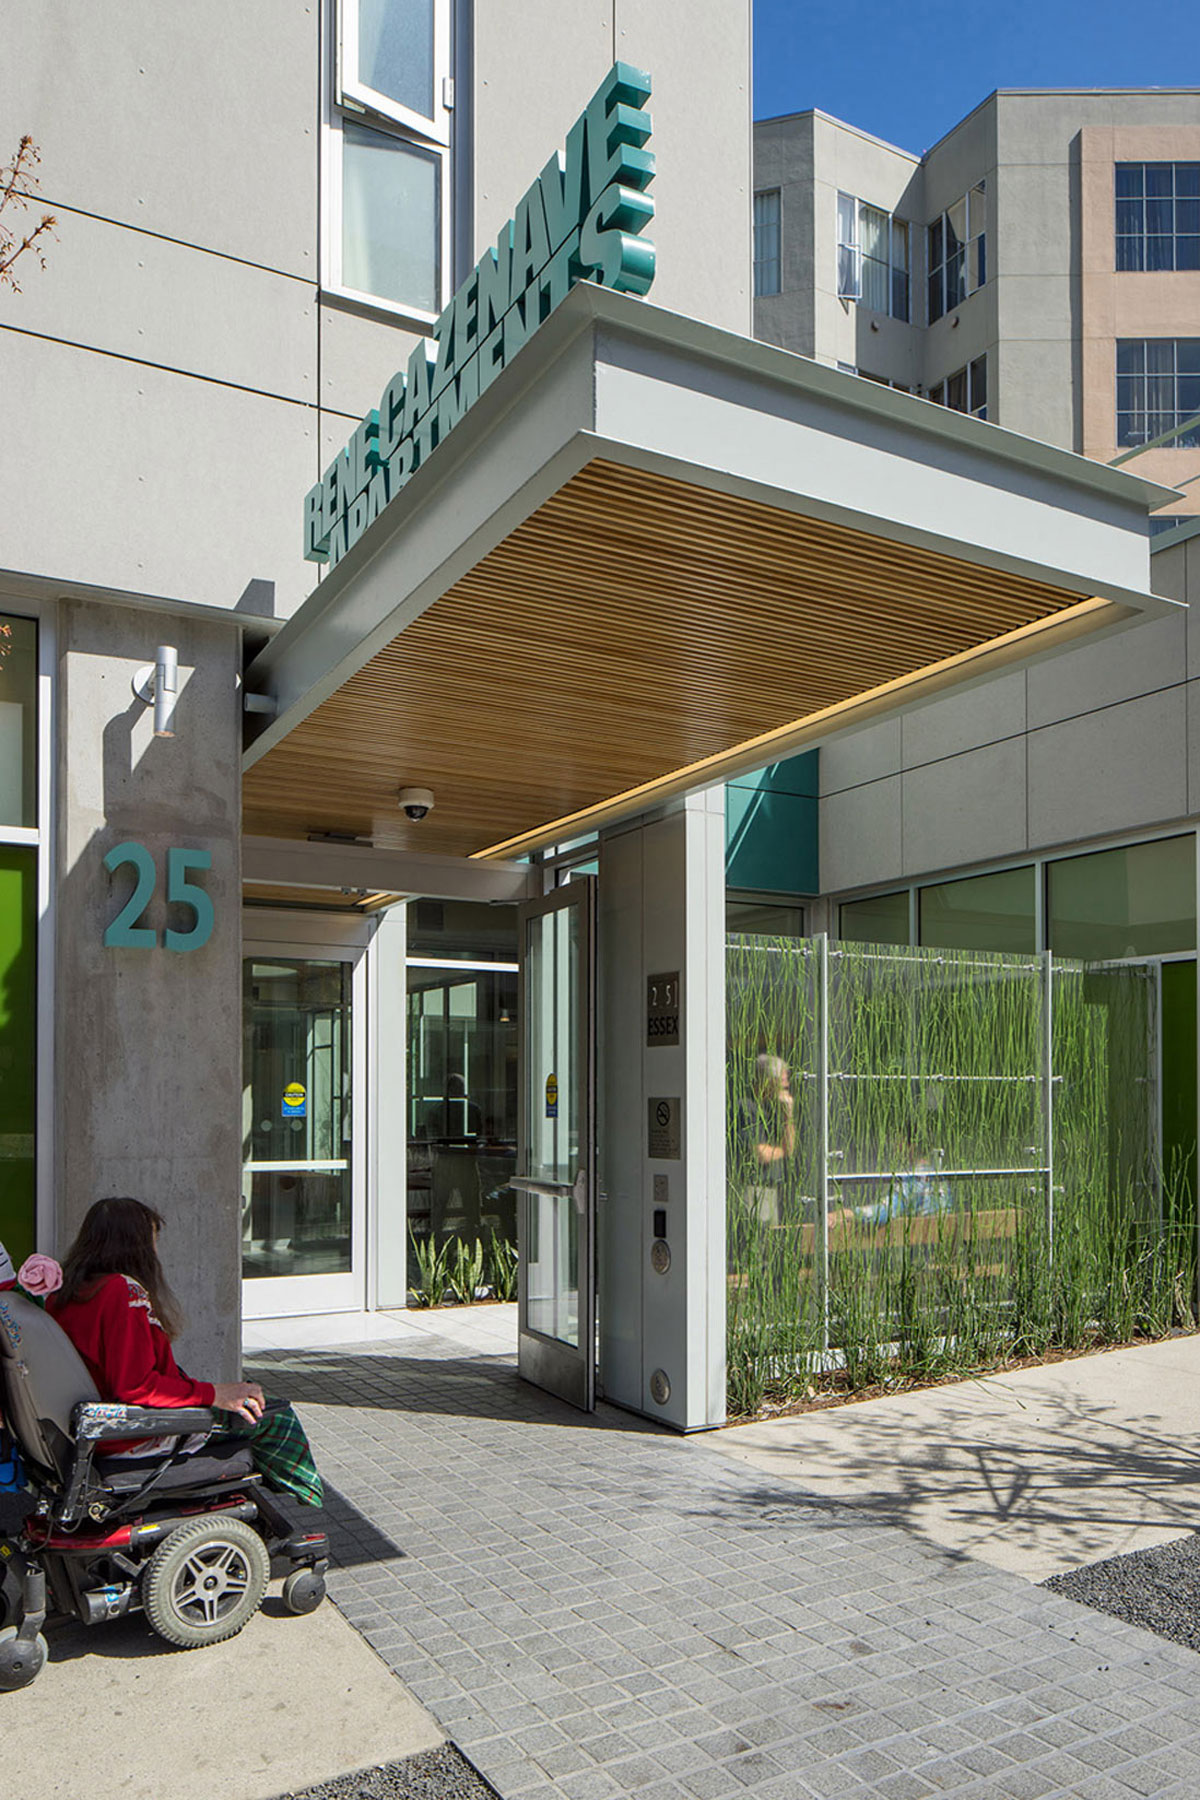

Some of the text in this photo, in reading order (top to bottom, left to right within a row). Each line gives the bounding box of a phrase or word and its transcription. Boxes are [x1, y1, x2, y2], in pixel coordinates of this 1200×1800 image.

[304, 61, 655, 564] RENE CAZENAVE
[103, 841, 215, 953] 25
[648, 1016, 679, 1036] ESSEX
